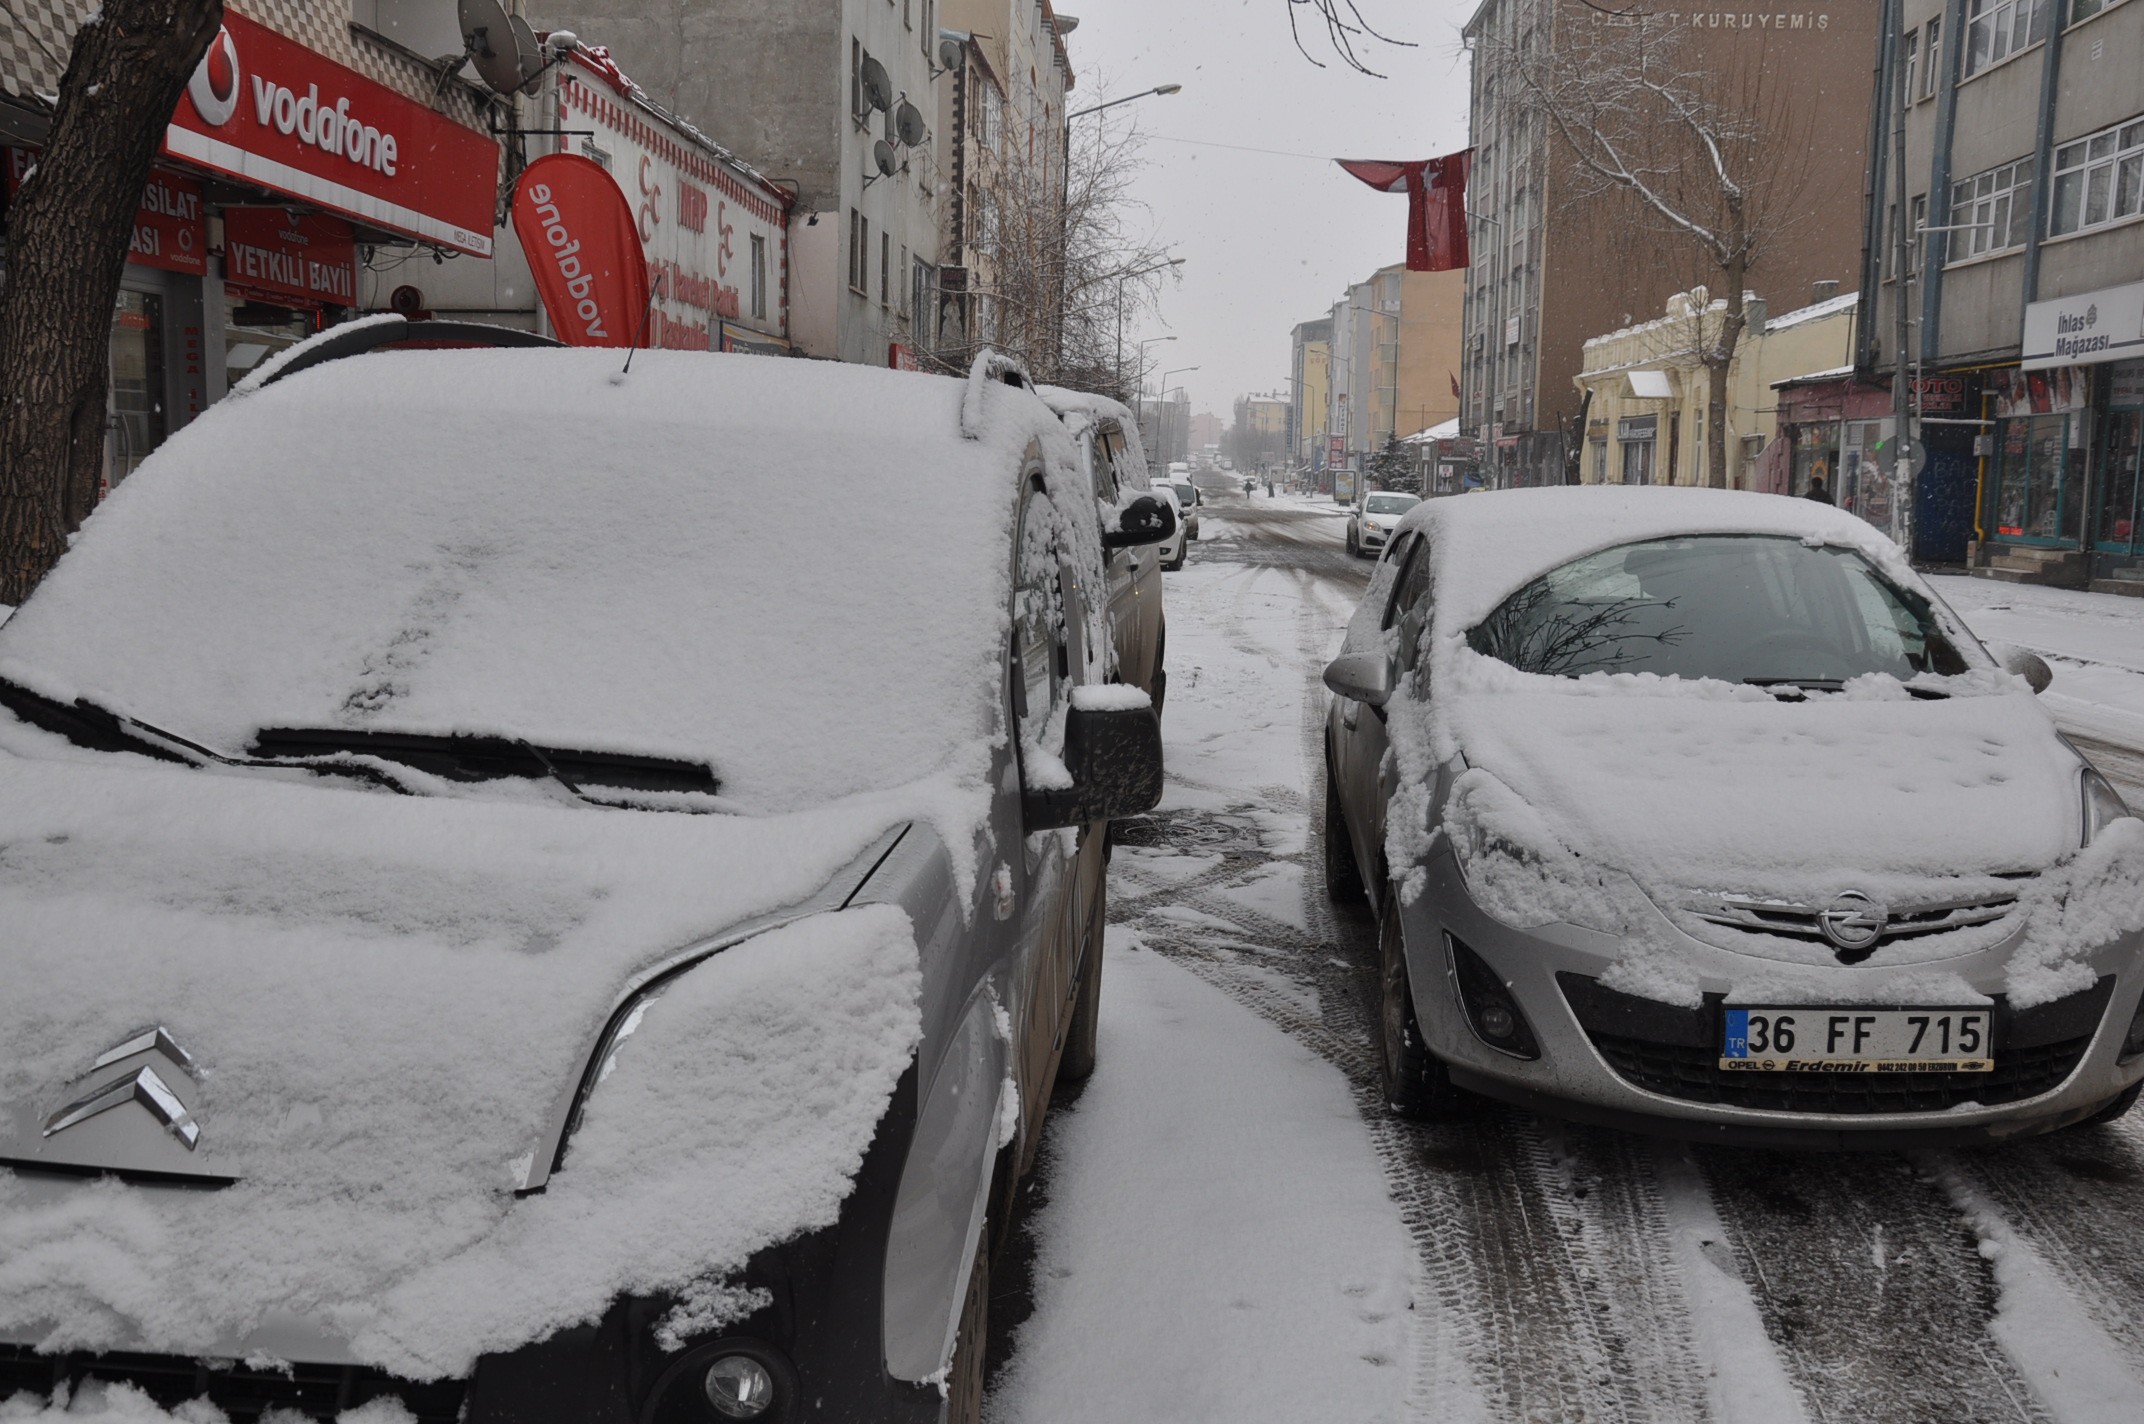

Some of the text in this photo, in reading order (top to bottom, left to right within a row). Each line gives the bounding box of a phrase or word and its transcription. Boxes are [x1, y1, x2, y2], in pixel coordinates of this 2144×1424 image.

[1692, 11, 1829, 32] KURUYEMİŞ
[251, 74, 397, 177] vodafone
[129, 224, 160, 256] ASI
[279, 229, 309, 246] vodafone
[170, 252, 201, 266] vodafone
[231, 241, 304, 288] YETKİLİ
[309, 261, 351, 298] BAYİİ
[2058, 310, 2085, 335] İhlas
[2055, 335, 2109, 359] Mağazası
[1728, 1037, 1746, 1049] TR
[1748, 1016, 1981, 1054] 36 FF 715
[1728, 1061, 1760, 1070] OPEL
[1785, 1060, 1870, 1072] Erdemir
[1877, 1062, 1894, 1072] 0442
[1895, 1062, 1908, 1072] 242
